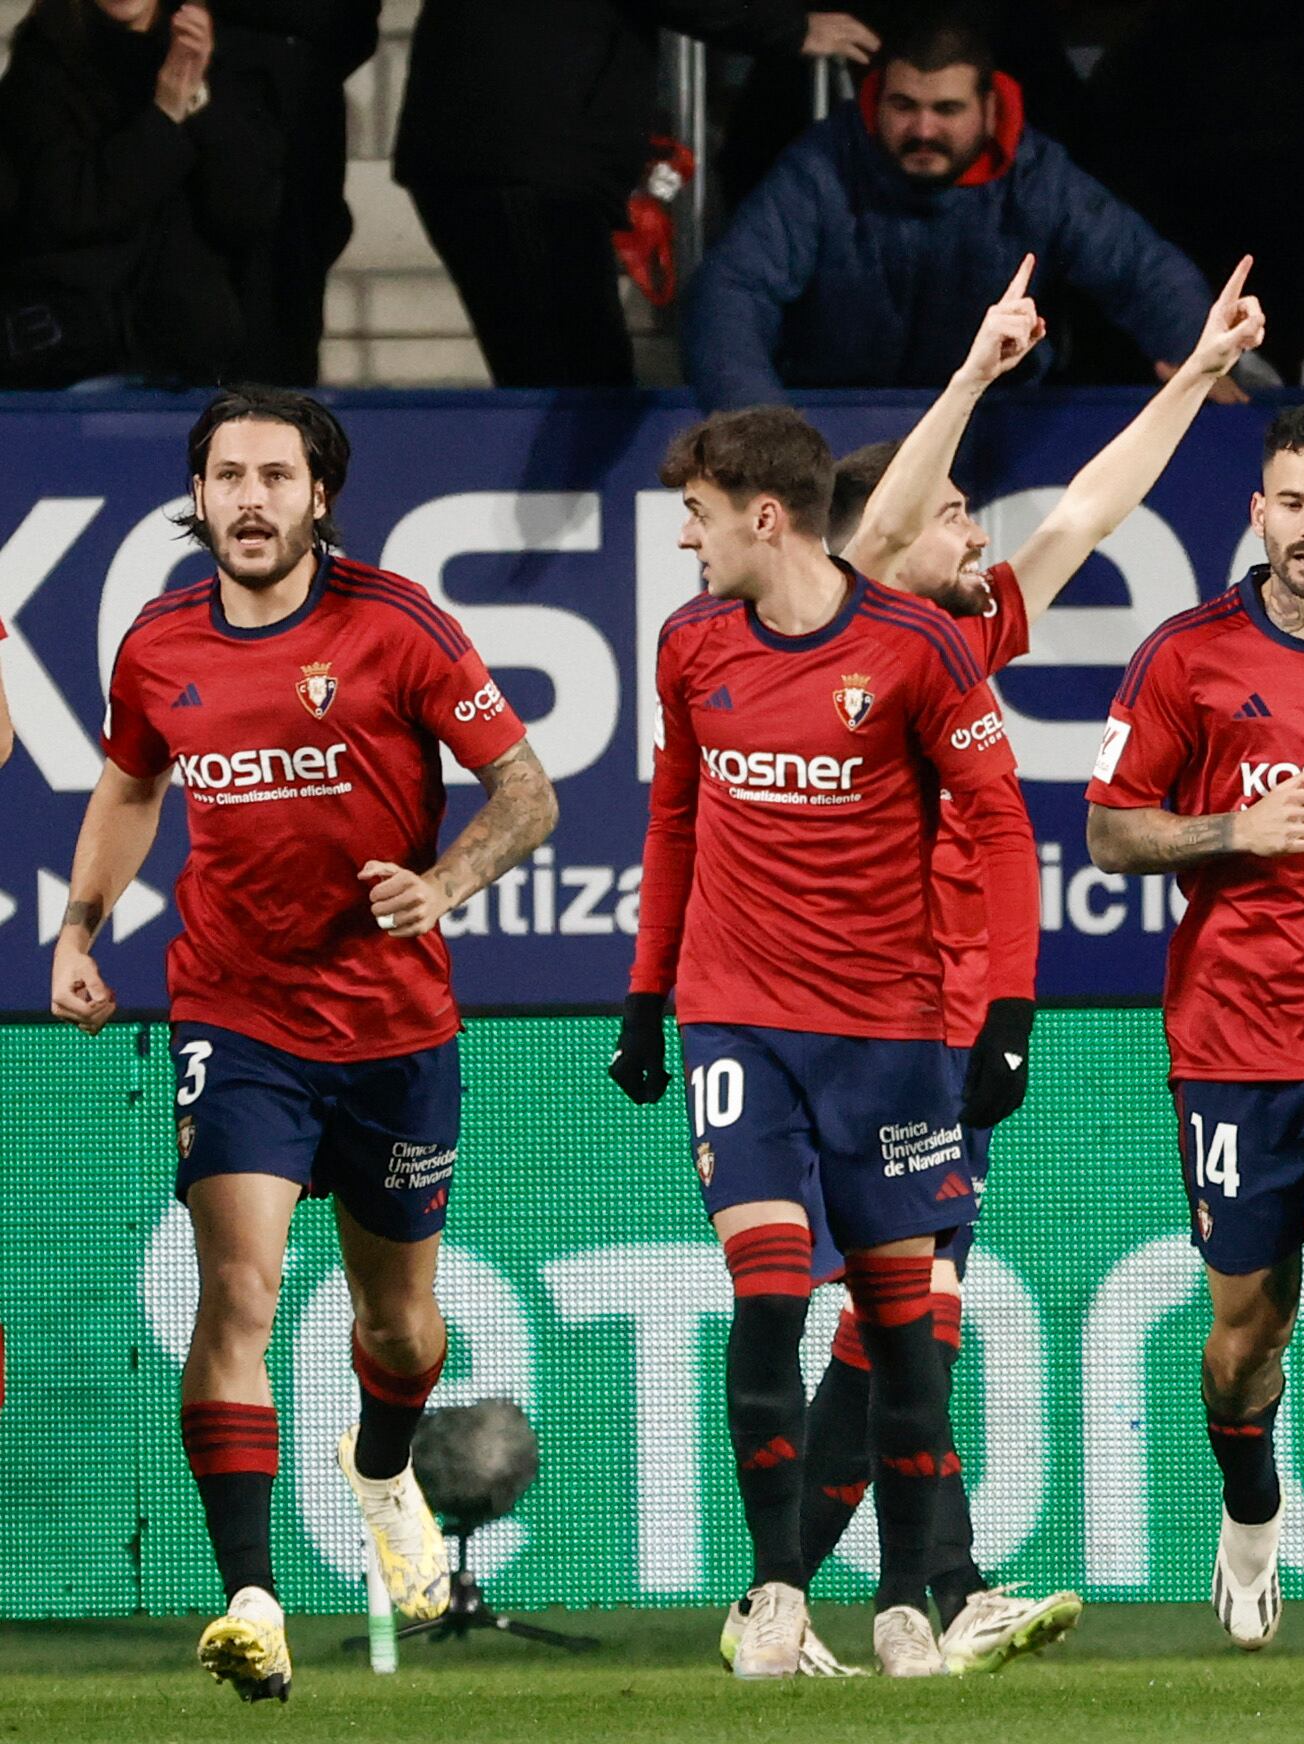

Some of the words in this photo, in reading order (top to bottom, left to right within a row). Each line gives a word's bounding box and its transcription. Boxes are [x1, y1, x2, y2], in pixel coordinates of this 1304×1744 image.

[178, 743, 347, 789] kosner
[216, 786, 298, 805] Climatización
[300, 781, 352, 798] eficiente
[729, 787, 807, 805] Climatización
[809, 793, 862, 807] eficiente
[177, 1040, 213, 1107] 3
[691, 1057, 745, 1138] 10
[881, 1122, 963, 1161] Universidad
[1190, 1111, 1241, 1198] 14
[384, 1173, 406, 1190] de
[408, 1165, 453, 1189] Navarra
[883, 1159, 906, 1178] de
[907, 1145, 962, 1174] Navarra
